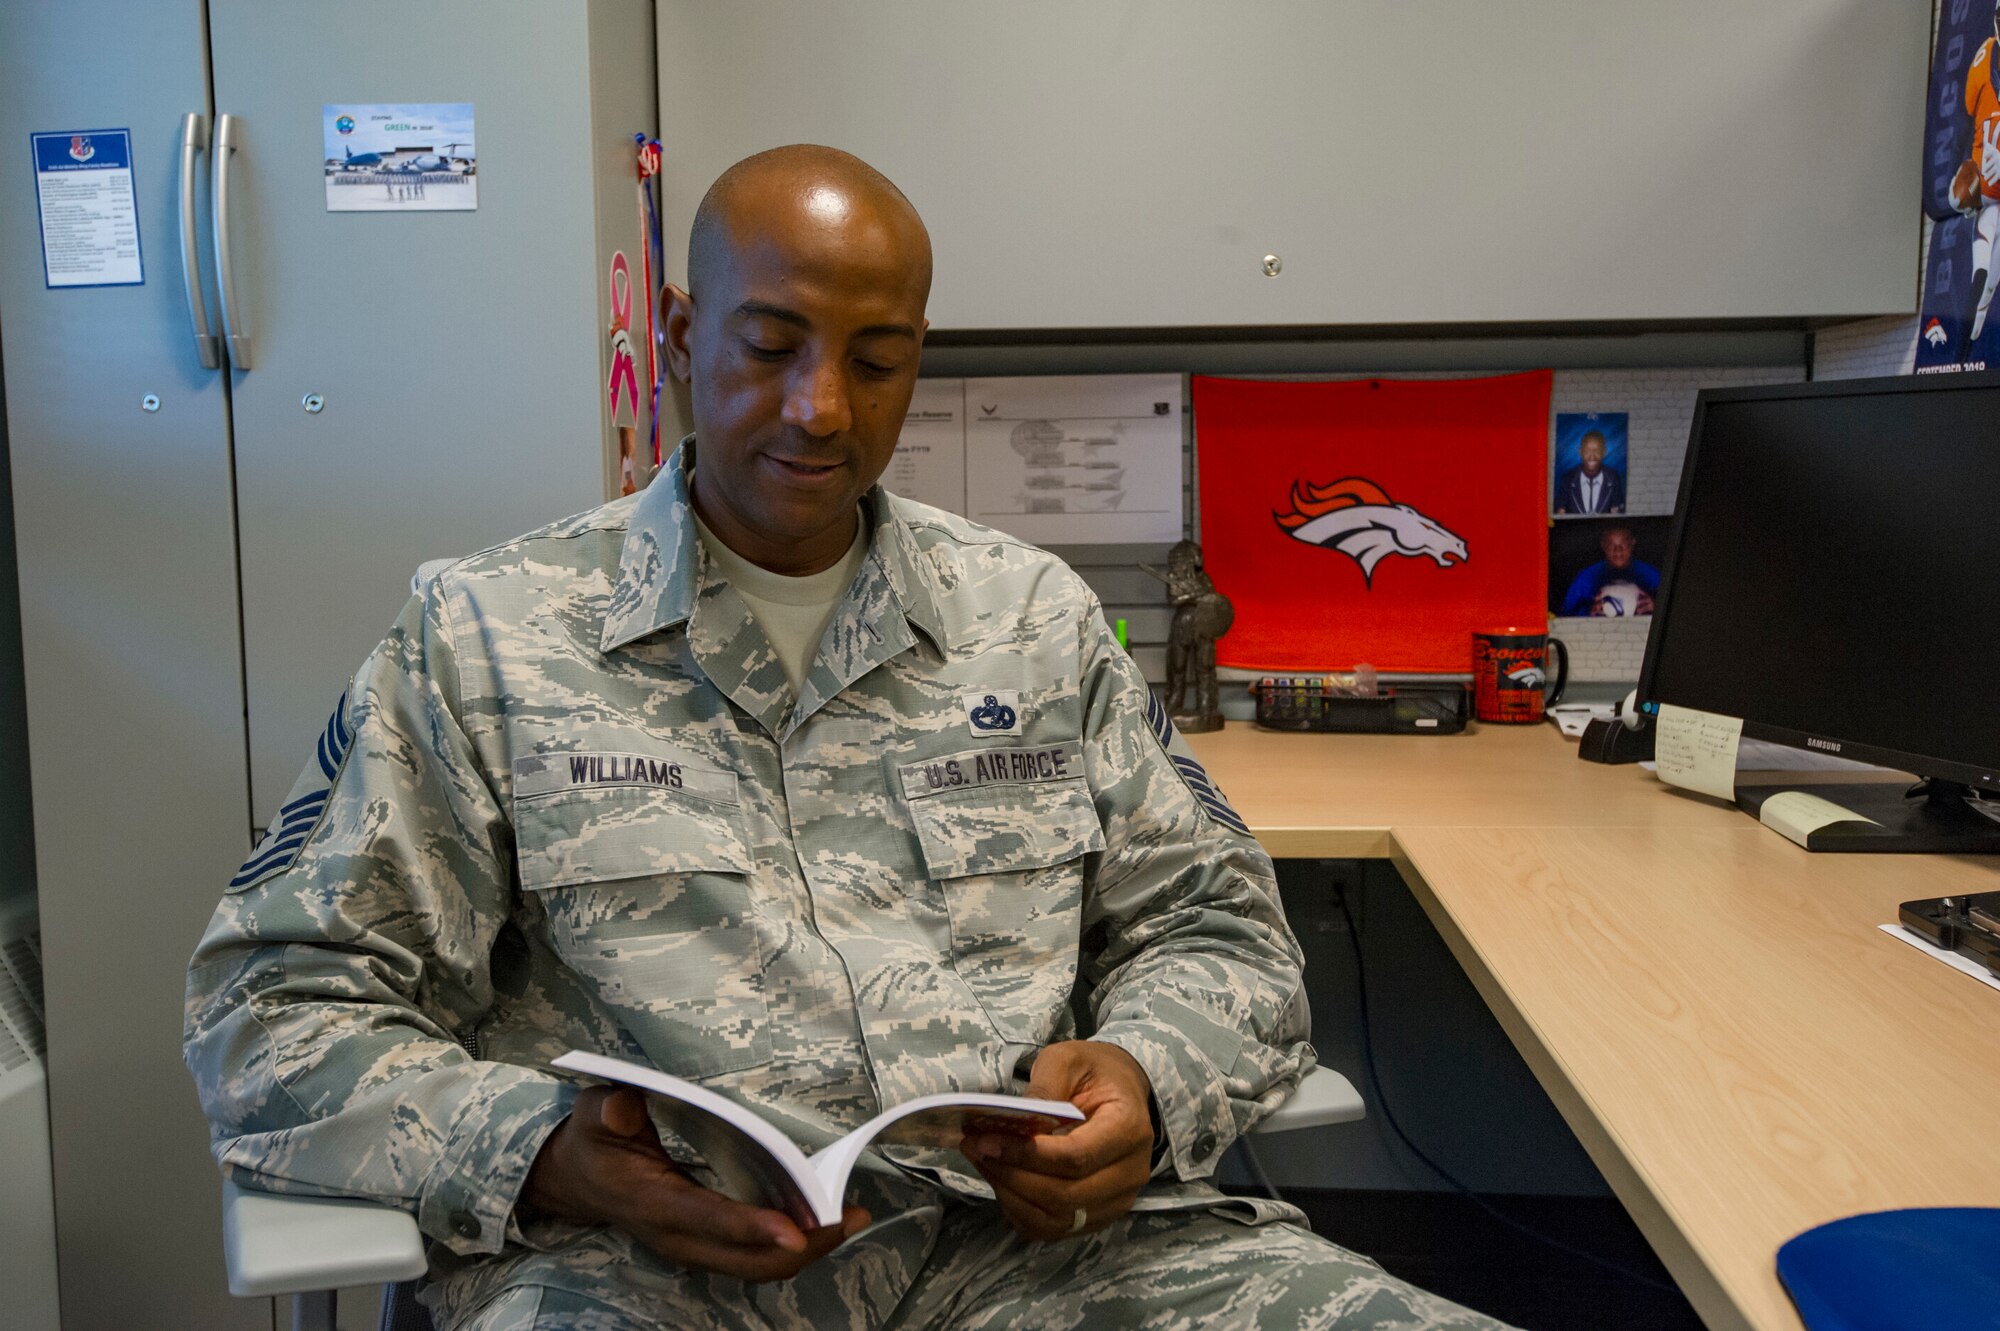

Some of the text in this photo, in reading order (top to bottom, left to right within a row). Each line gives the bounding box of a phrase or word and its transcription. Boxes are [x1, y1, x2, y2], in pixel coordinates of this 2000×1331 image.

[384, 123, 410, 131] GREEN
[1807, 737, 1841, 752] SAMSUNG
[570, 756, 683, 788] WILLIAMS
[925, 749, 1067, 788] U.S. AIR FORCE
